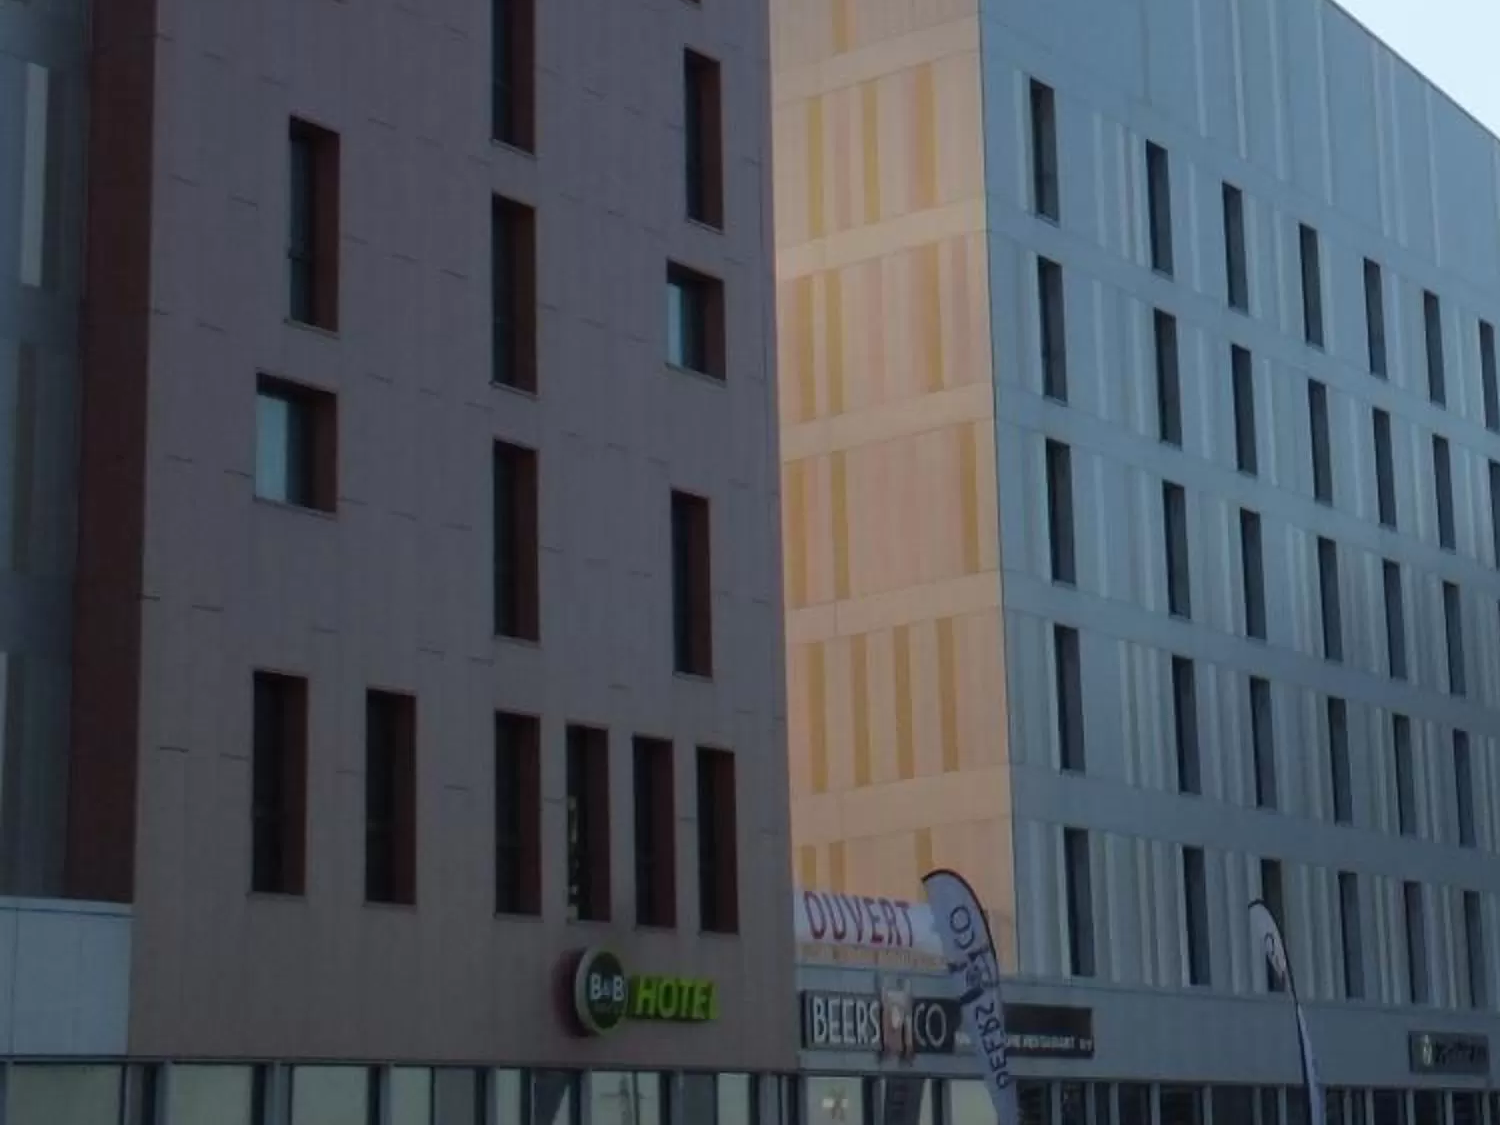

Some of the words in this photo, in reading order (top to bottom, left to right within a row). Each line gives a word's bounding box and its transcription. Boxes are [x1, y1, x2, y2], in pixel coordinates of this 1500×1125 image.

[804, 891, 913, 948] OUVERT
[812, 995, 881, 1047] BEERS
[913, 1001, 948, 1048] CO
